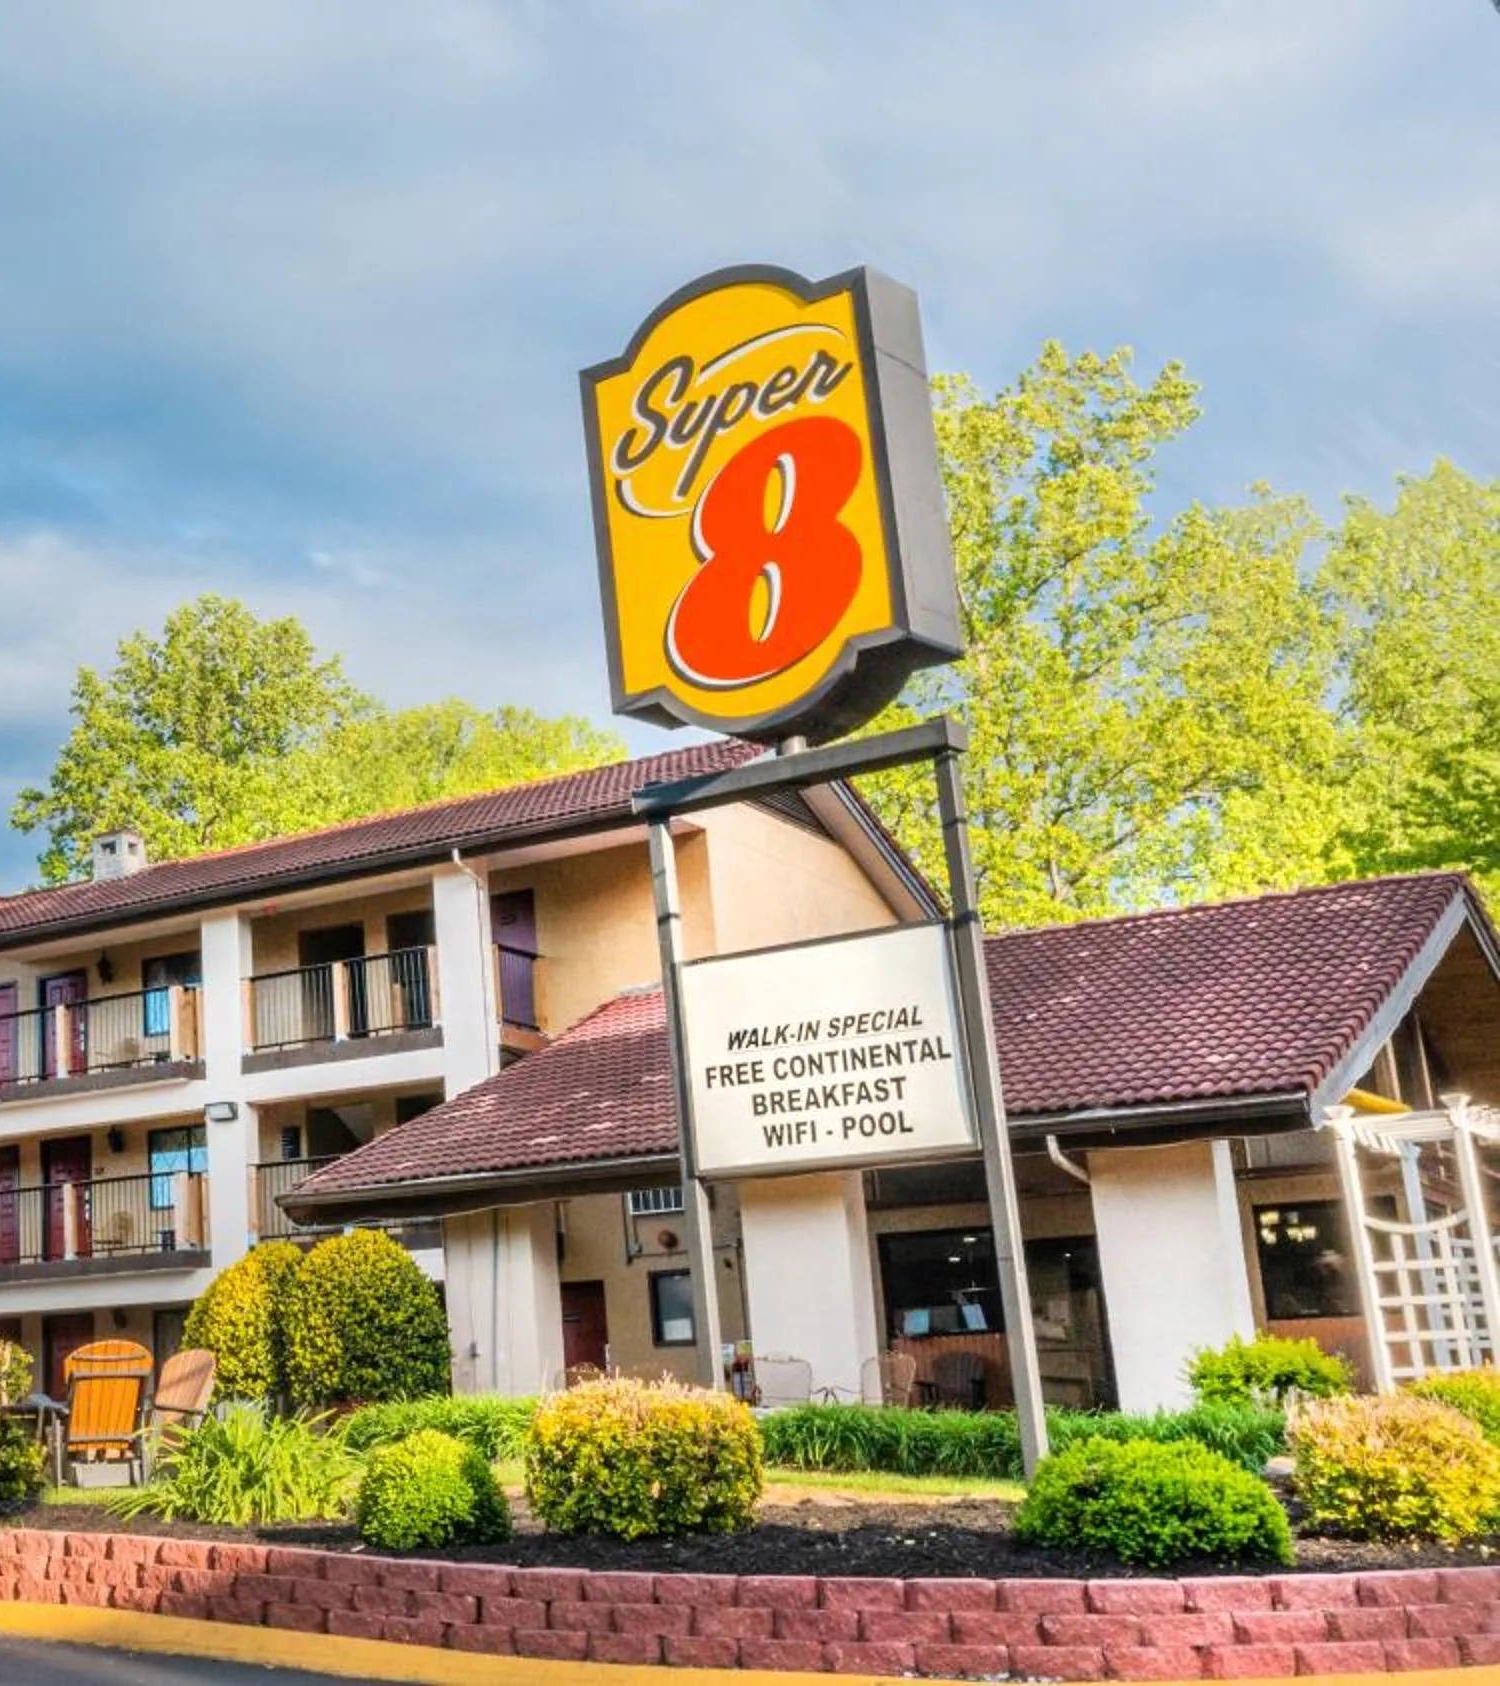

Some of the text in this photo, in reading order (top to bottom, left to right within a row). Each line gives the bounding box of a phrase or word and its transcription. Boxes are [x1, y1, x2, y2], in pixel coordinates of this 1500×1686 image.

[612, 349, 852, 501] Super
[664, 416, 863, 691] 8
[728, 1005, 923, 1050] WALK-IN SPECIAL
[706, 1036, 951, 1089] FREE CONTINENTAL
[752, 1076, 907, 1116] BREAKFAST
[763, 1121, 817, 1147] WIFI
[842, 1110, 913, 1139] POOL
